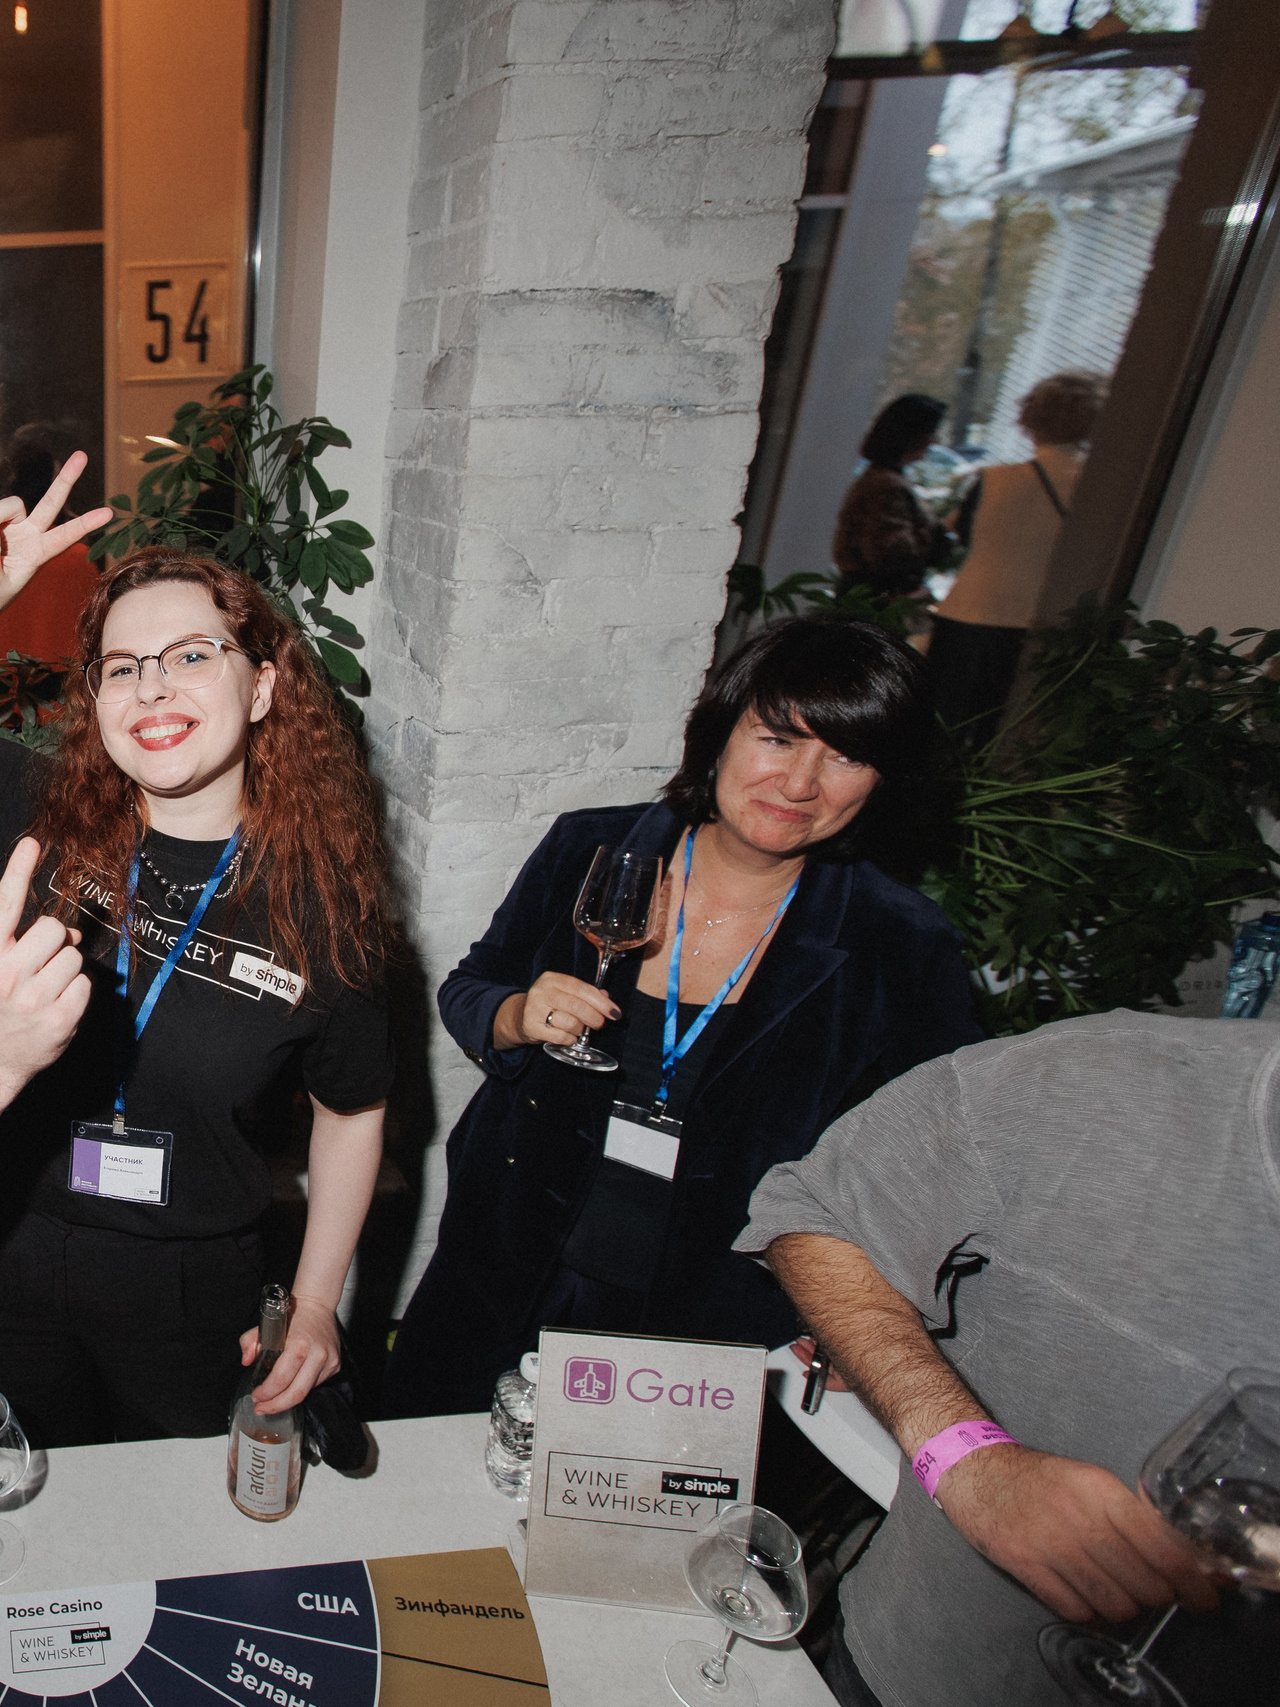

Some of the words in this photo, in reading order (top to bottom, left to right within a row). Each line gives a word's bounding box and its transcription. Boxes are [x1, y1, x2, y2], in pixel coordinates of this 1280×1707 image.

[146, 279, 209, 364] 54
[240, 963, 253, 976] by
[255, 967, 298, 995] simple
[104, 1155, 143, 1165] УЧАСТНИК
[626, 1368, 735, 1411] Gate
[247, 1444, 266, 1495] arkuri
[914, 1451, 937, 1481] 054
[564, 1468, 629, 1489] WINE
[669, 1479, 682, 1489] by
[684, 1477, 731, 1494] simple
[561, 1489, 577, 1505] &
[587, 1491, 701, 1517] WHISKEY
[6, 1606, 45, 1619] Rose
[49, 1599, 103, 1614] Casino
[297, 1592, 360, 1616] США
[394, 1597, 526, 1620] Зинфандель
[19, 1636, 55, 1649] WINE
[82, 1630, 108, 1641] simple
[20, 1652, 30, 1664] &
[33, 1646, 95, 1661] WHISKEY
[235, 1638, 314, 1690] Новая
[226, 1662, 318, 1707] Зелан
